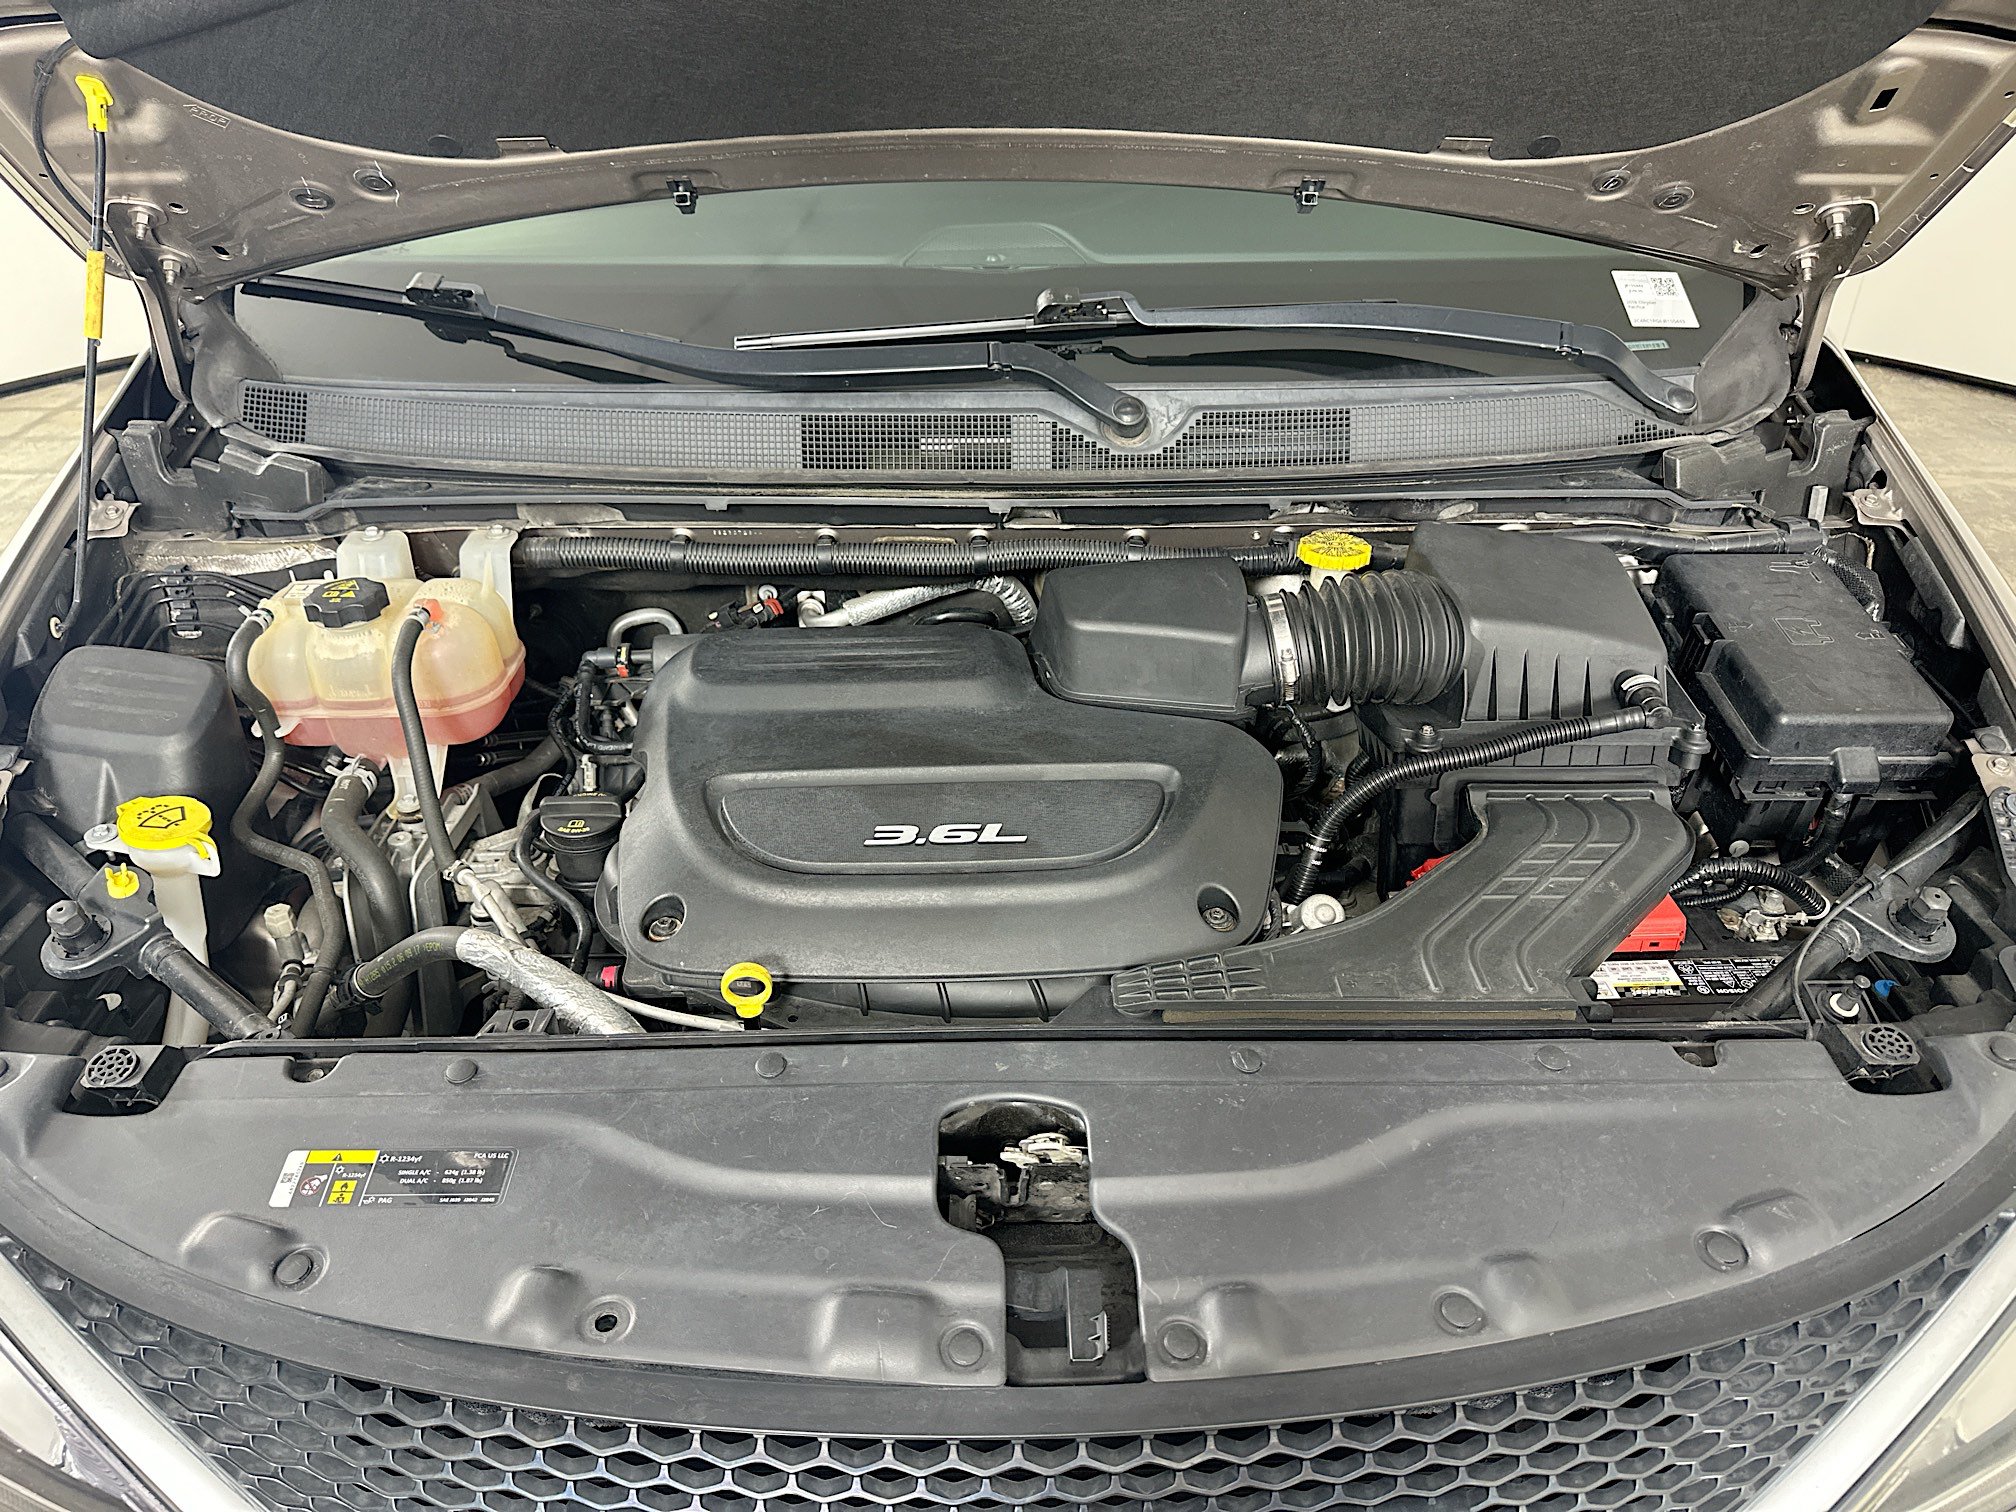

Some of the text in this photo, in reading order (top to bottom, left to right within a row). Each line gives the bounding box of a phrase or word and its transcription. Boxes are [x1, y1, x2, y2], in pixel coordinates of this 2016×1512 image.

[864, 823, 1028, 846] 3.6L
[389, 1155, 423, 1163] R-1234yf
[377, 1197, 393, 1205] PAG
